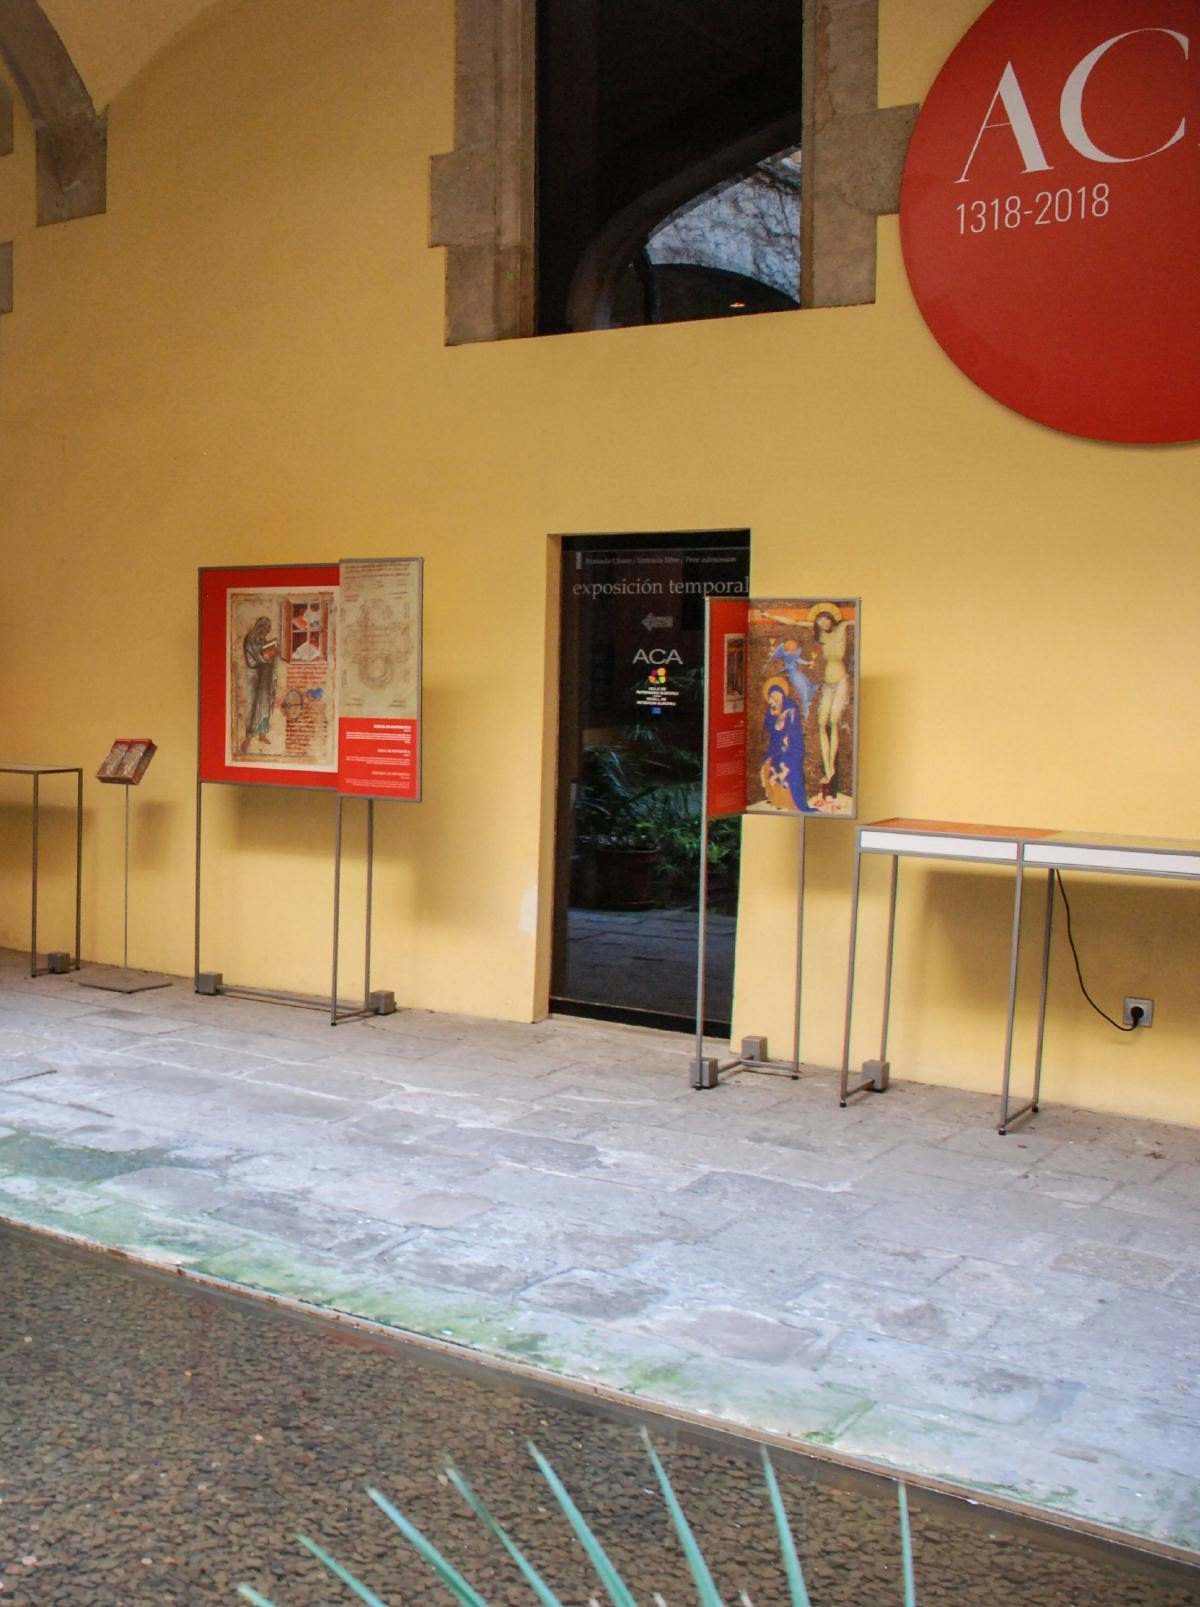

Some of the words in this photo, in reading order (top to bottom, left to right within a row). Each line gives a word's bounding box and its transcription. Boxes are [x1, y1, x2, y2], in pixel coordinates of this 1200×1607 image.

[954, 28, 1200, 184] AC
[956, 183, 1110, 235] 1318-2018
[572, 578, 663, 600] exposición
[669, 575, 749, 598] temporal
[632, 648, 683, 665] ACA
